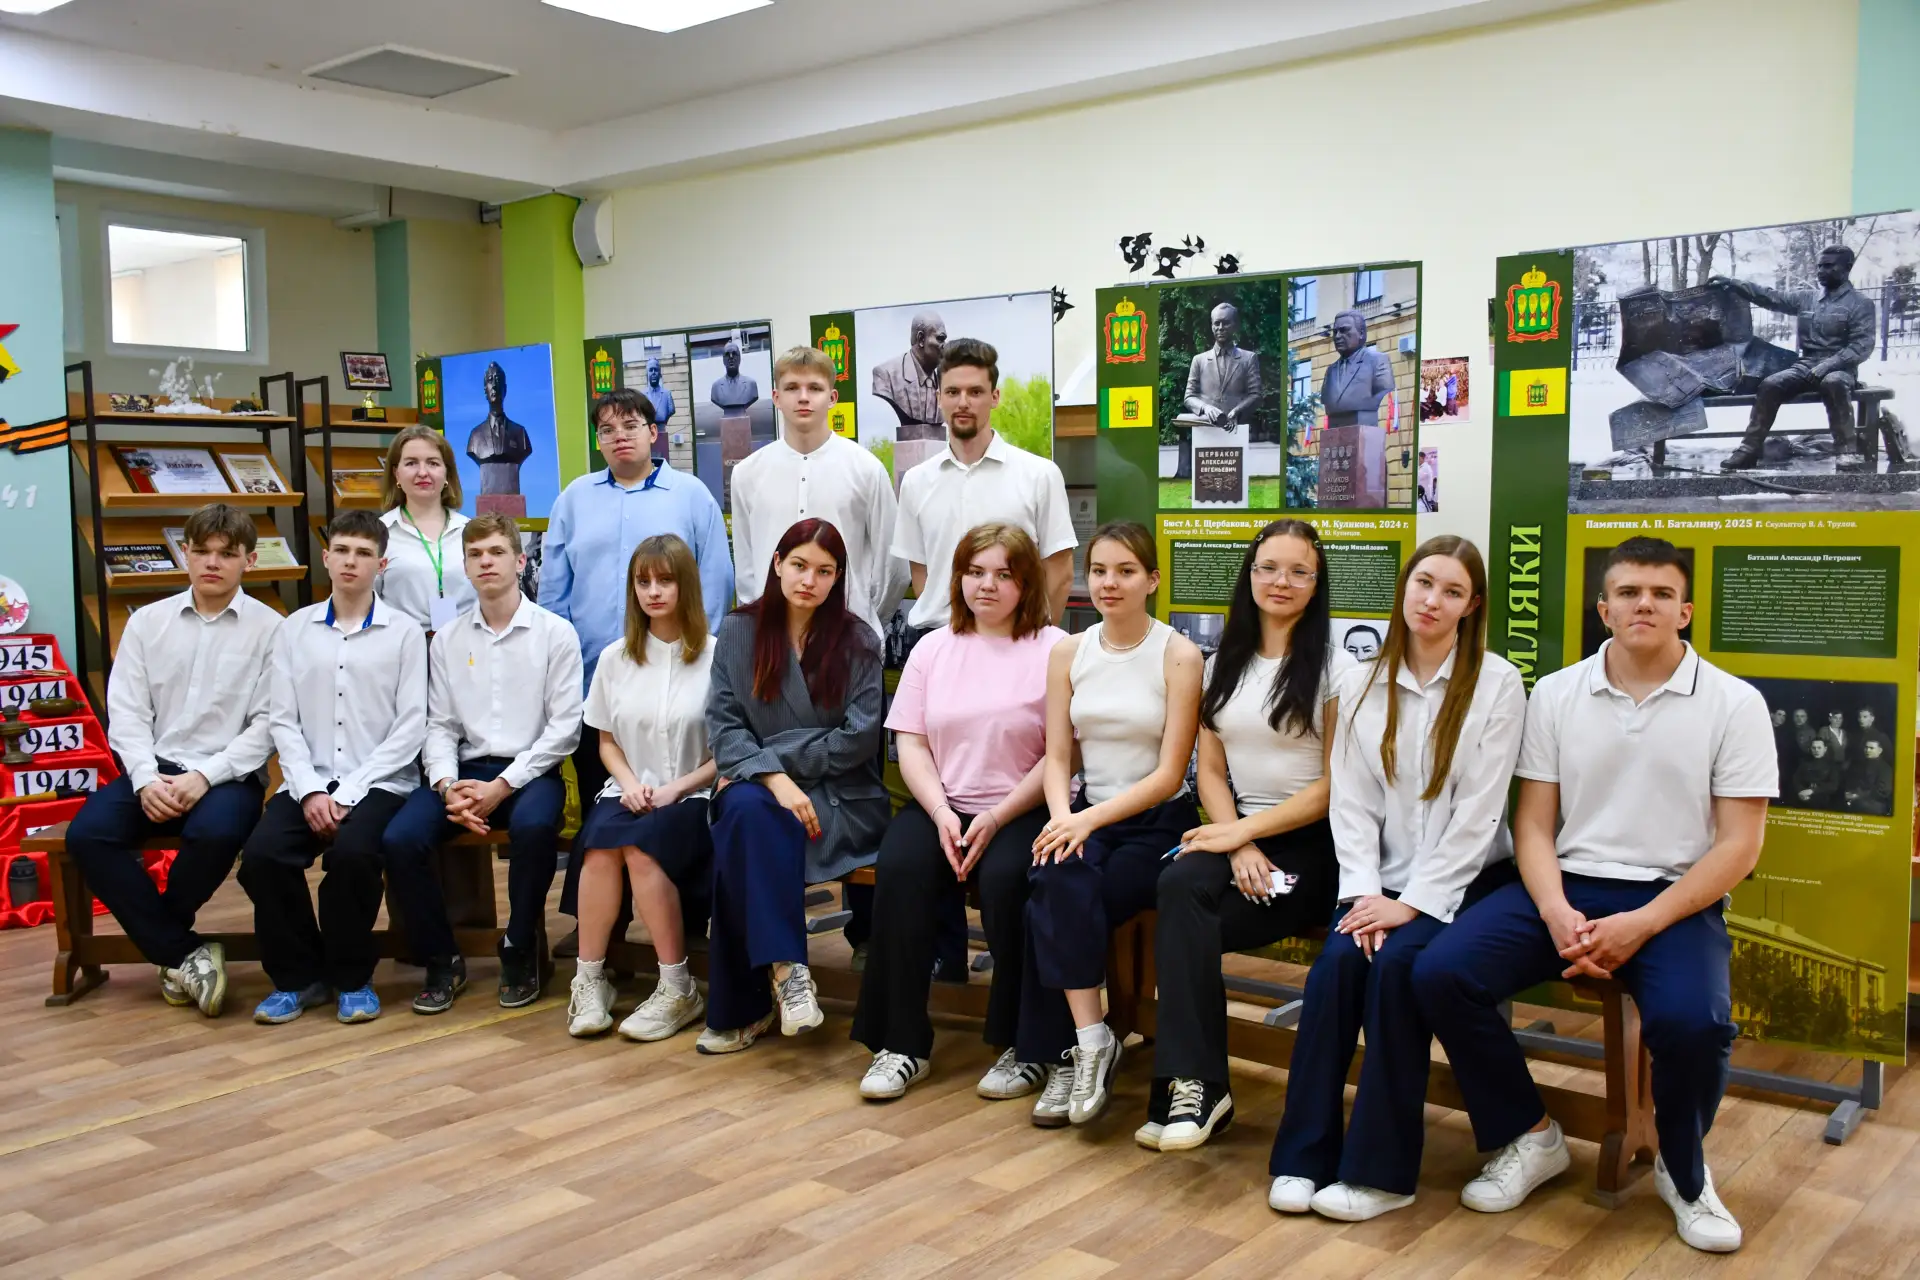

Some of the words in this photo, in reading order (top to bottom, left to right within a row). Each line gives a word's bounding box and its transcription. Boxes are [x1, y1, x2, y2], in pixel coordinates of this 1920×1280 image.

[1163, 520, 1183, 528] Бюст
[1185, 520, 1193, 528] А.
[1194, 520, 1202, 528] Е.
[1203, 520, 1252, 530] Щербакова,
[1321, 520, 1332, 528] М.
[1333, 520, 1377, 529] Куликова,
[1379, 520, 1401, 529] 2024
[1586, 520, 1639, 529] Памятник
[1641, 520, 1651, 528] А.
[1654, 520, 1664, 528] П.
[1667, 519, 1723, 531] Баталину,
[1725, 518, 1753, 528] 2025
[1765, 521, 1807, 529] Скульптор
[1202, 542, 1232, 550] Александр
[1780, 554, 1821, 562] Александр
[1822, 554, 1862, 562] Петрович
[1507, 524, 1541, 693] МЛЯКИ
[0, 645, 48, 670] 945
[0, 681, 63, 711] 944
[25, 724, 80, 753] 943
[20, 768, 92, 796] 1942
